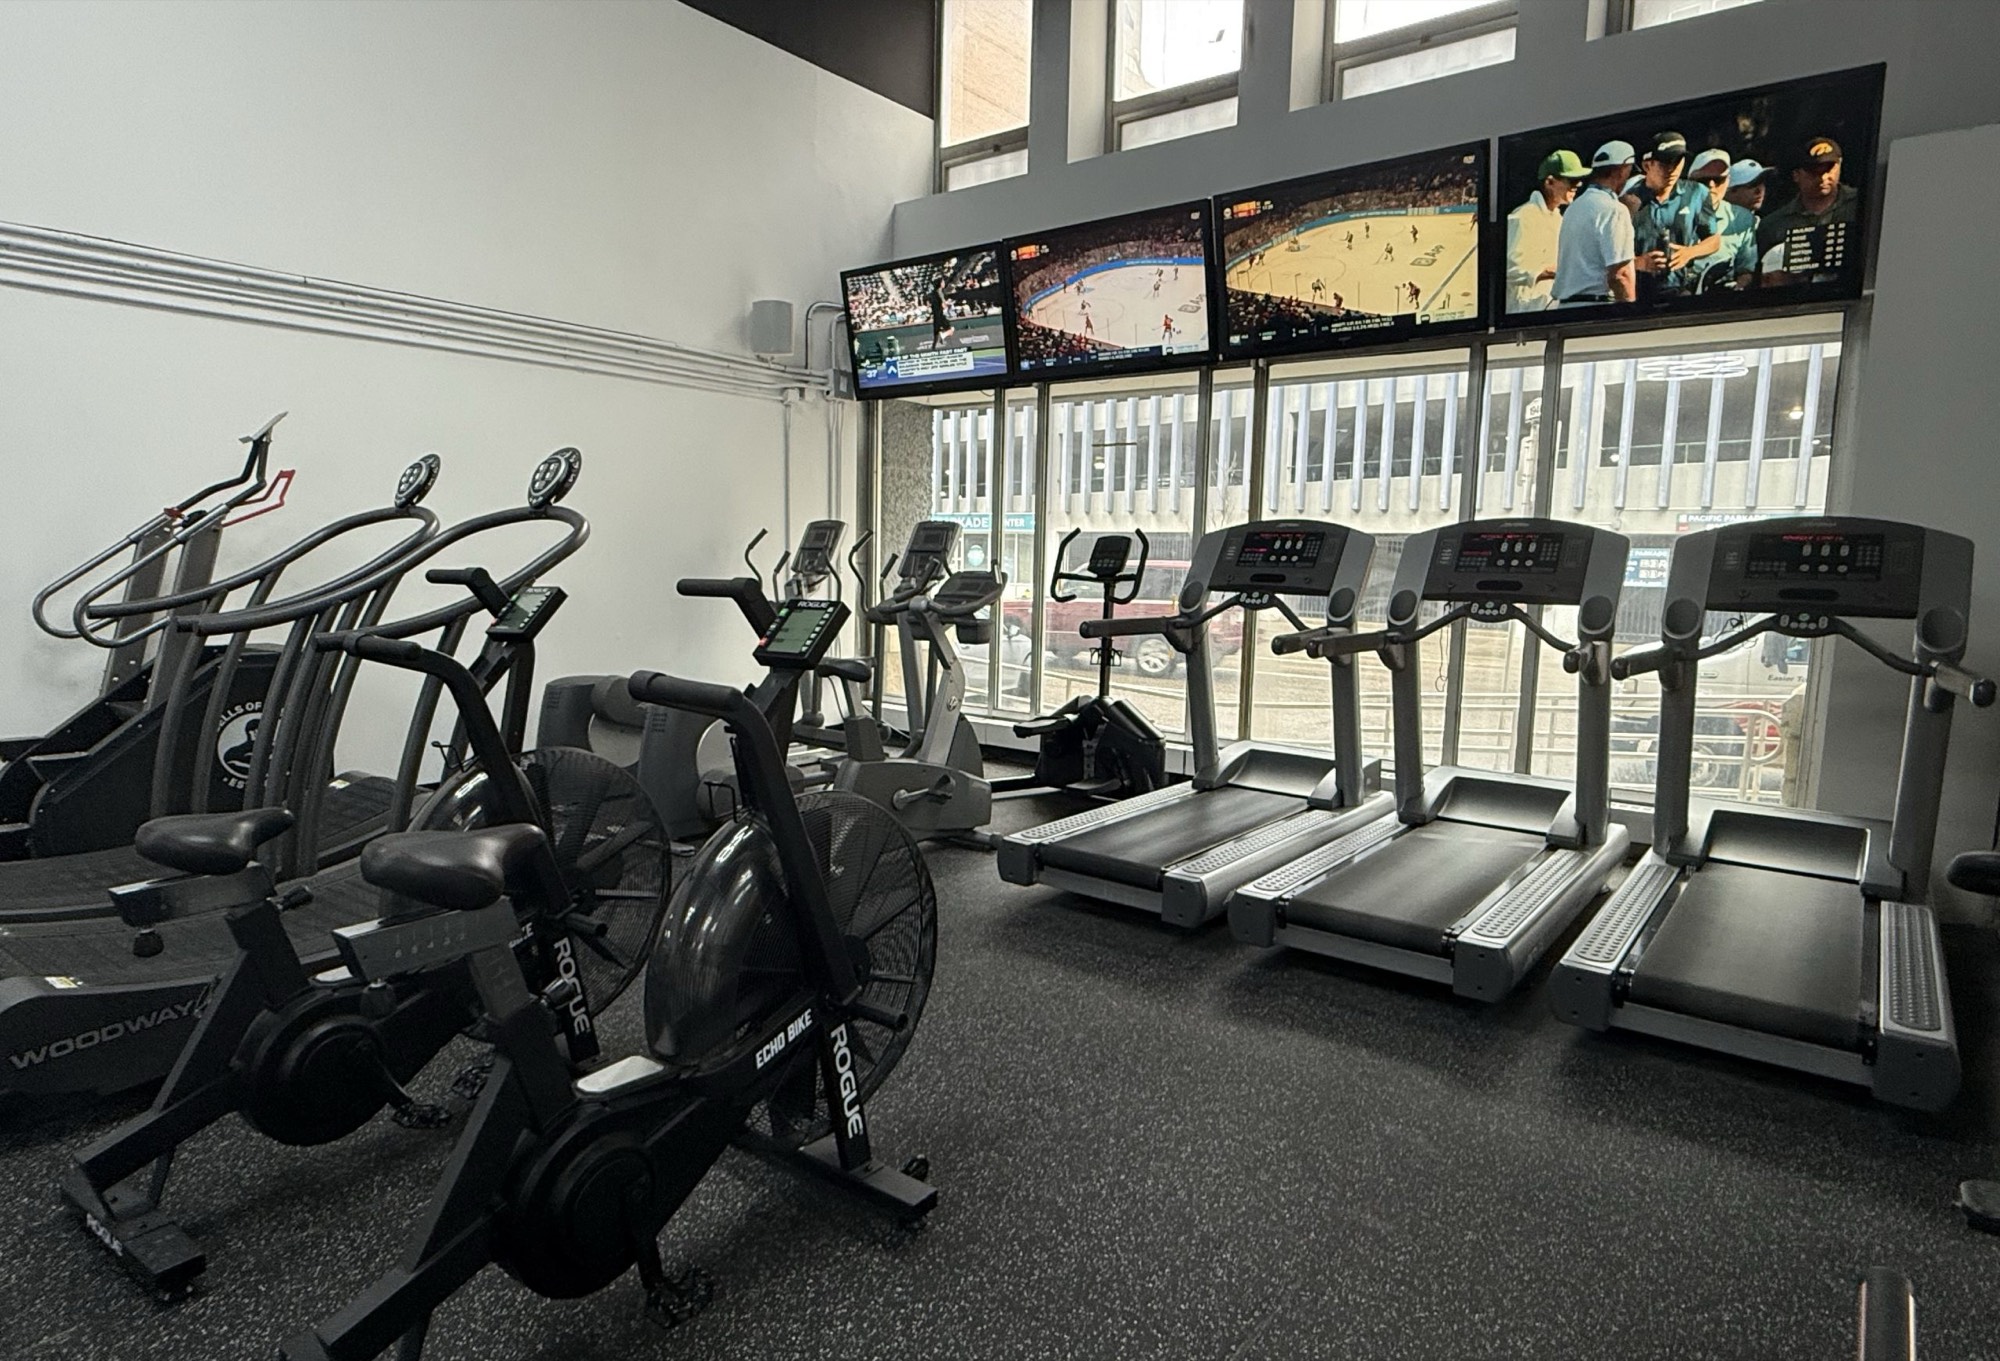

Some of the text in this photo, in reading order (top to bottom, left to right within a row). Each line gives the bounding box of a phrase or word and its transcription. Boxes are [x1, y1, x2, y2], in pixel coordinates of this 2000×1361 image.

[866, 369, 878, 378] 37
[1688, 514, 1722, 522] PACIFIC
[245, 701, 262, 711] OF
[9, 1000, 194, 1069] WOODWAY
[755, 1008, 813, 1069] ECHO BIKE
[830, 1023, 864, 1139] ROGUE
